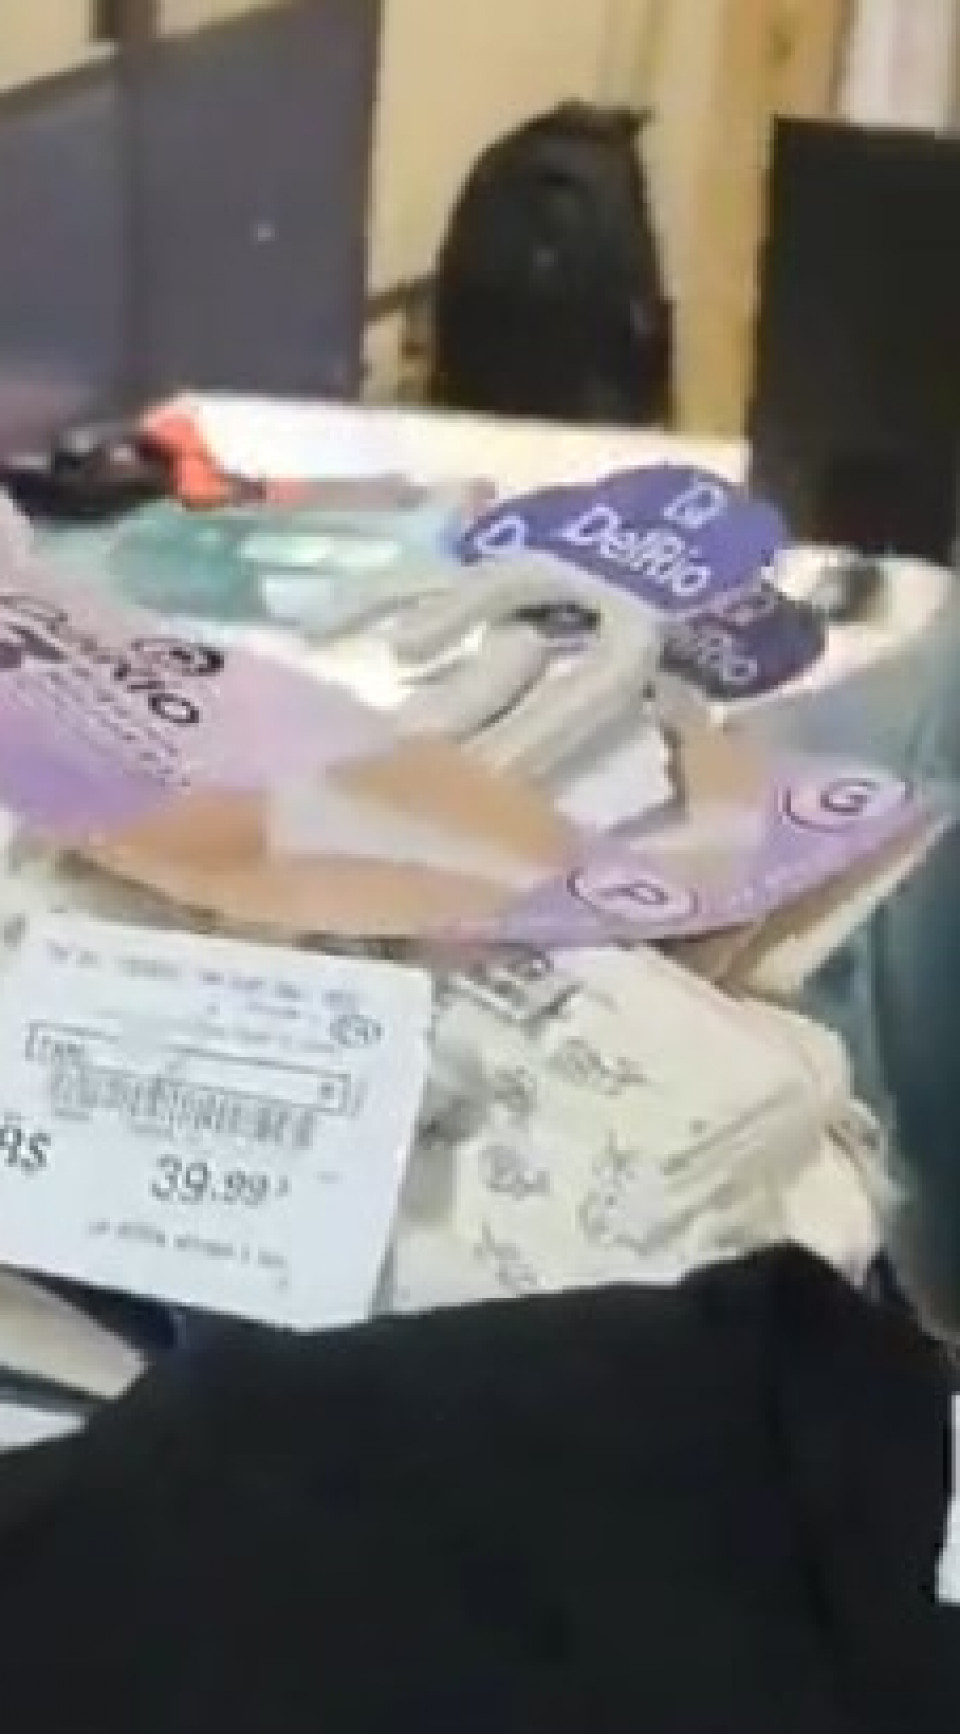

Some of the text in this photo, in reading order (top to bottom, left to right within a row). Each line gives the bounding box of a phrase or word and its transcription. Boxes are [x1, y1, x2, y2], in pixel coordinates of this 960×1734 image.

[556, 504, 712, 597] DelRio
[818, 776, 882, 817] G
[592, 881, 671, 906] P
